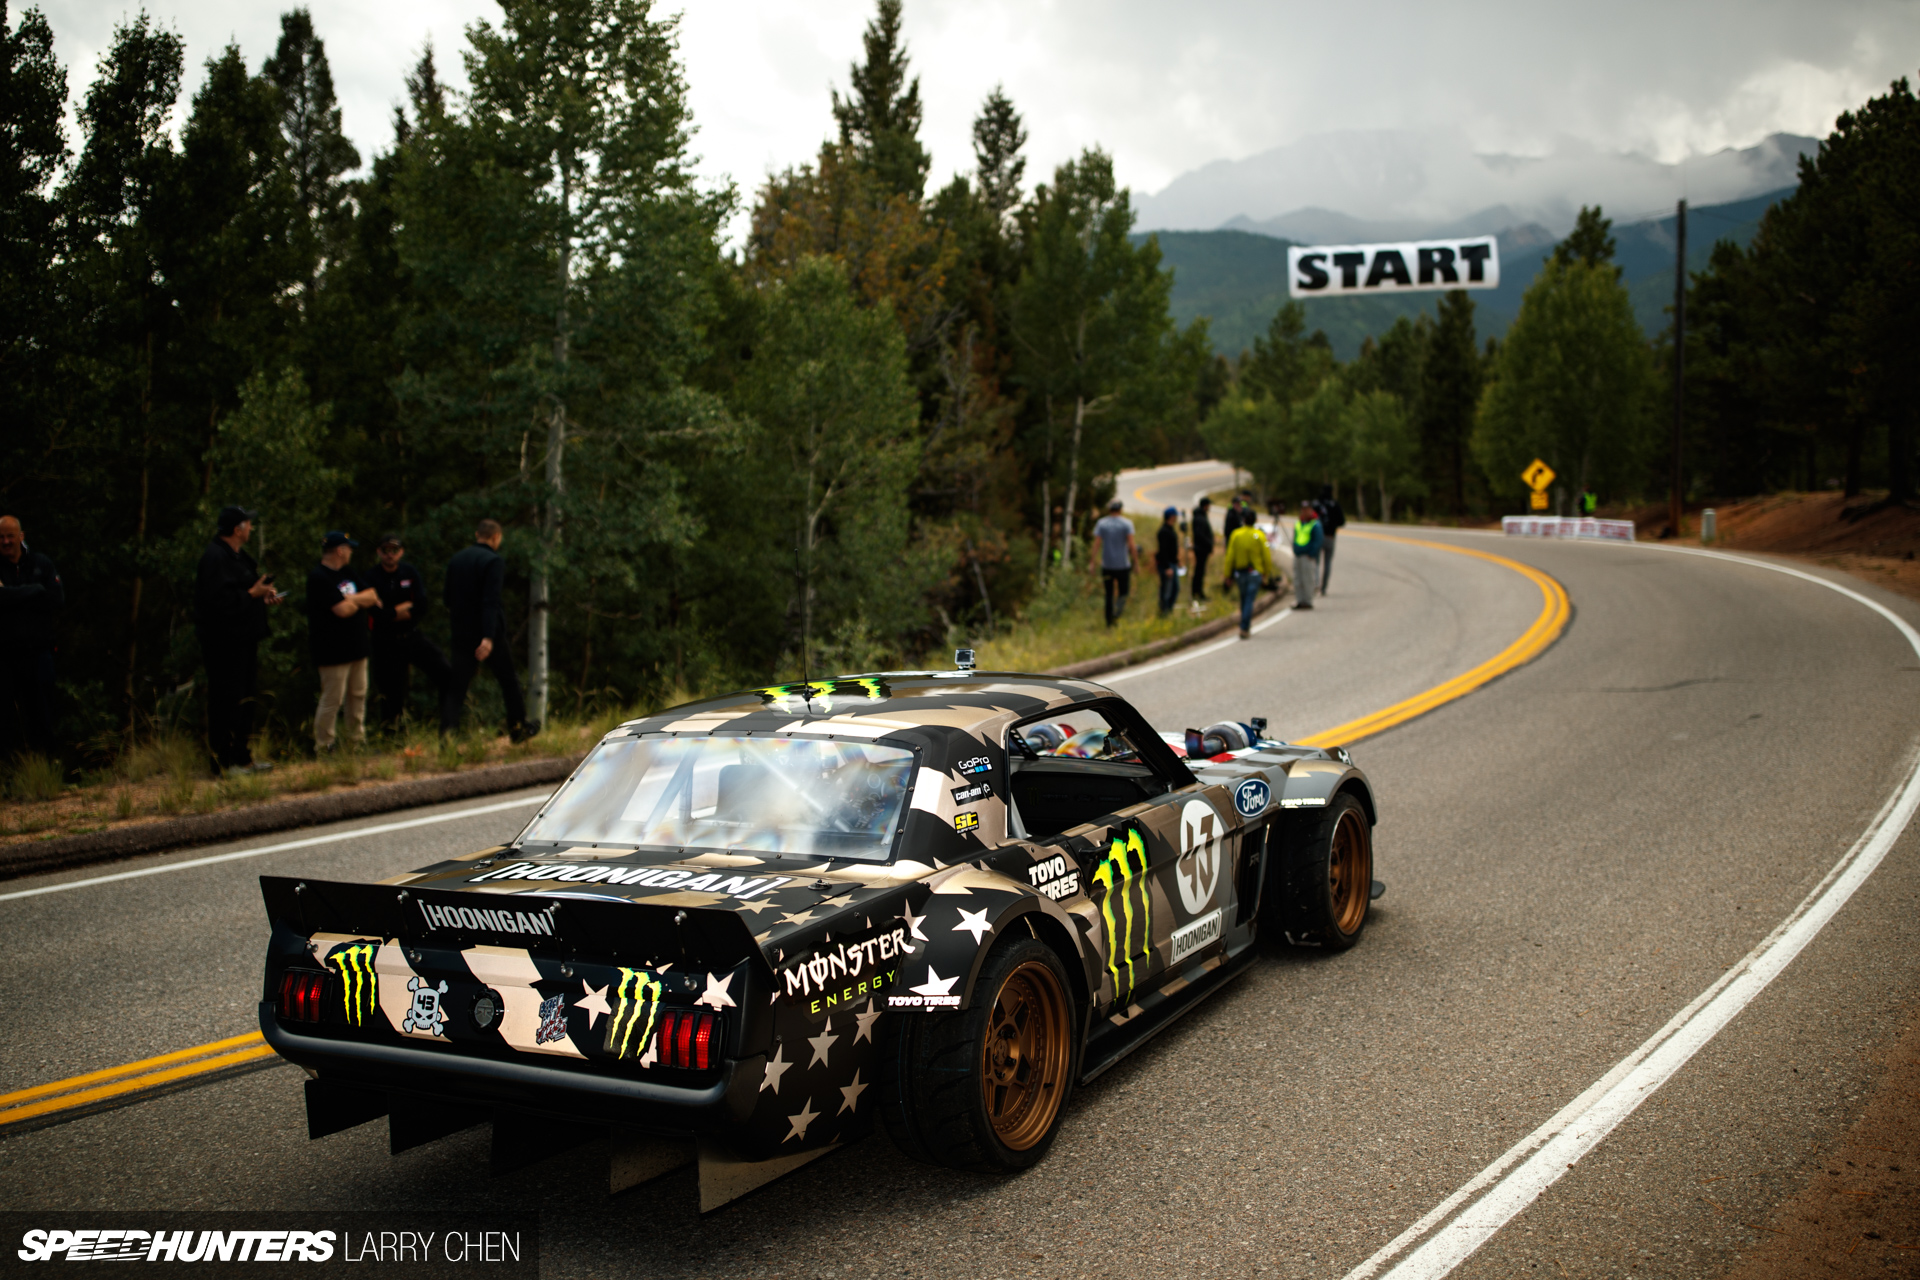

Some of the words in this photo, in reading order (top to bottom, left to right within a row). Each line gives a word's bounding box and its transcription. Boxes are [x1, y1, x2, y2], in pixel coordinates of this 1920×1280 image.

[1297, 243, 1491, 289] START
[958, 756, 990, 770] GoPro
[955, 787, 982, 801] can-am
[1242, 784, 1265, 812] Ford
[1028, 856, 1066, 887] TOYO
[1039, 872, 1078, 901] TIRES
[783, 927, 916, 997] MONSTER
[417, 994, 436, 1011] 43
[811, 969, 896, 1015] ENERGY
[888, 996, 923, 1006] TOYO
[923, 996, 961, 1006] TIRES
